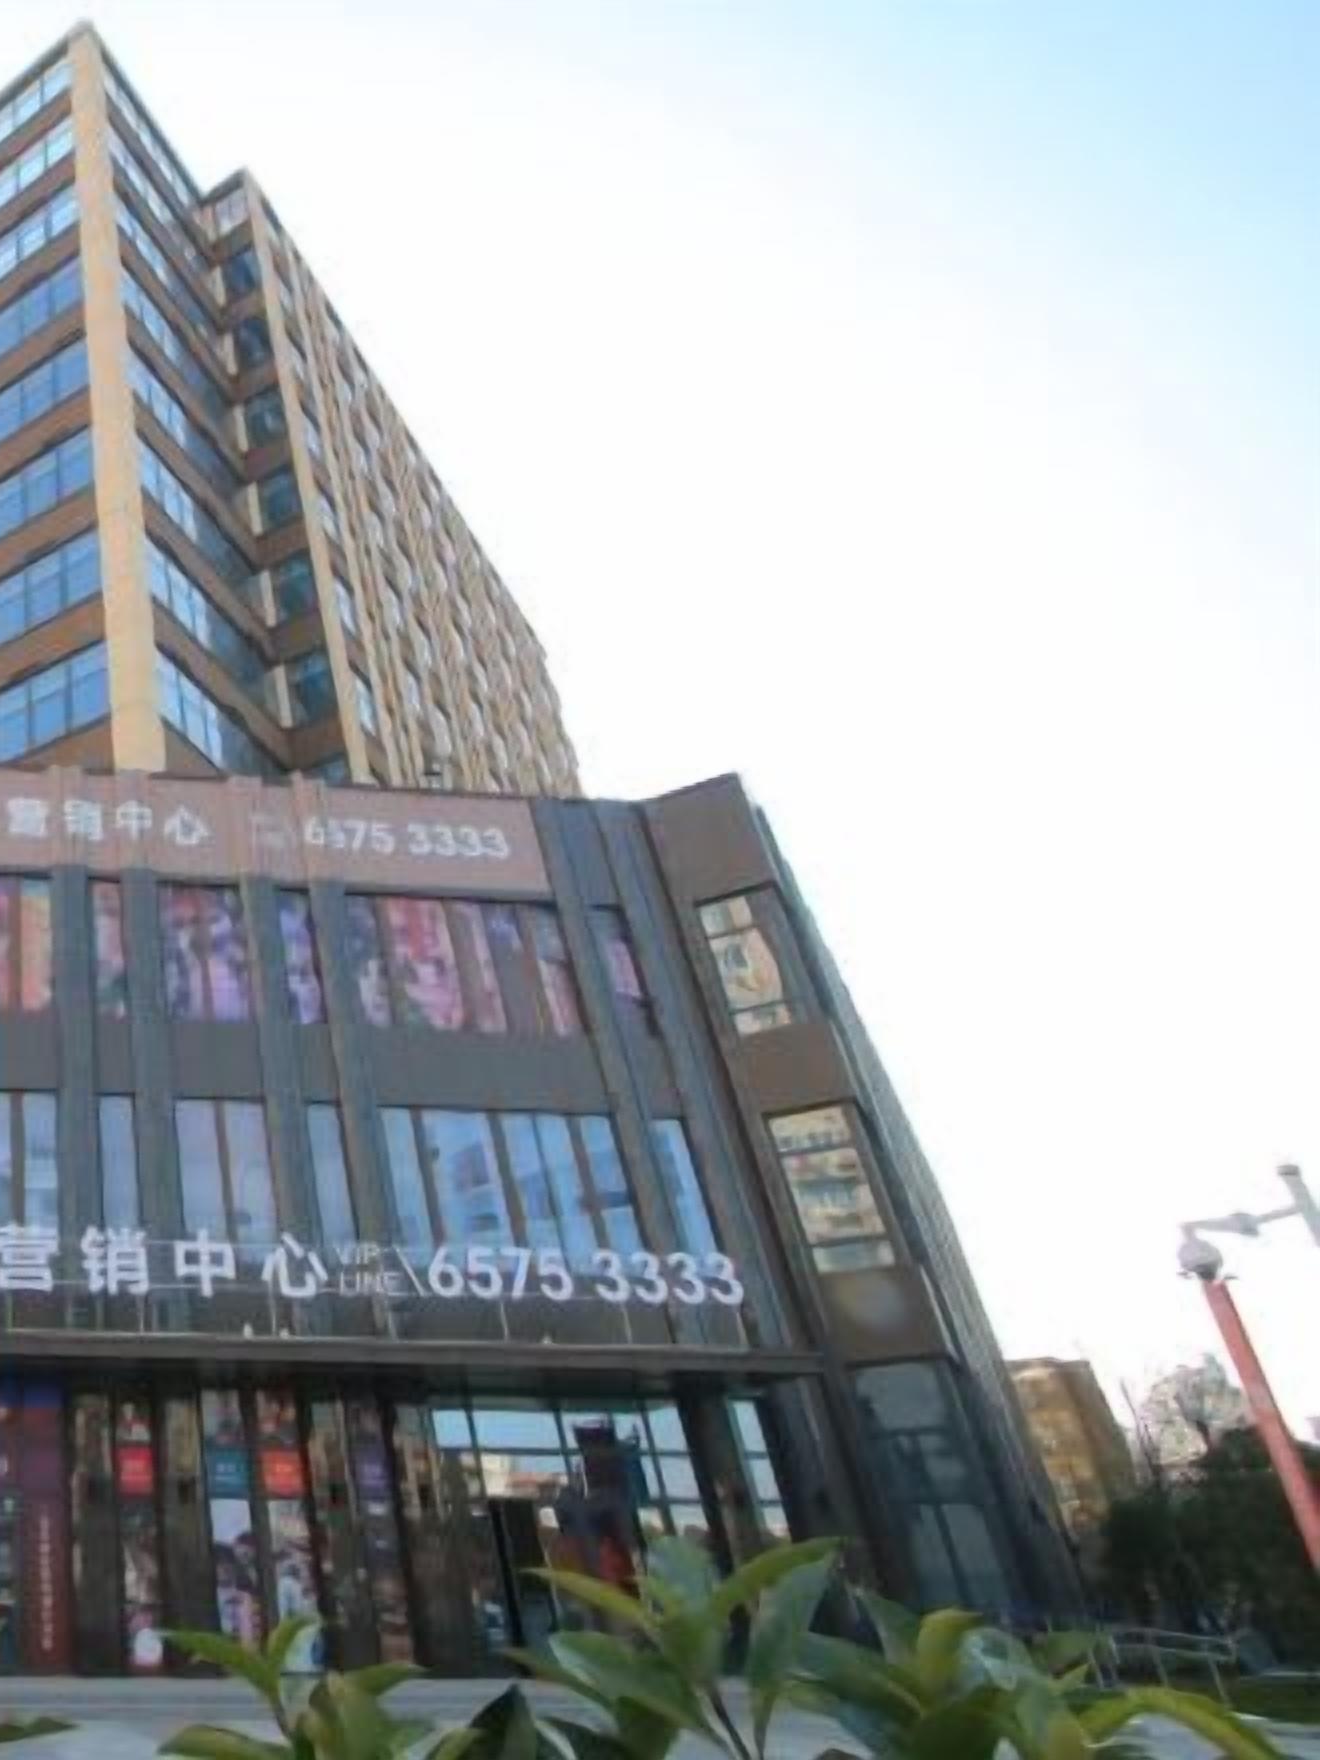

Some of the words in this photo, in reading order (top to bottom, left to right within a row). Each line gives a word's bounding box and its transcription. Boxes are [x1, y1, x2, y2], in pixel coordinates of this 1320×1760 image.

[6, 797, 212, 845] 营销中心
[407, 822, 510, 860] 3333
[334, 1245, 379, 1266] VIP
[337, 1270, 403, 1296] LINE
[427, 1245, 574, 1301] 6575
[591, 1249, 744, 1306] 3333
